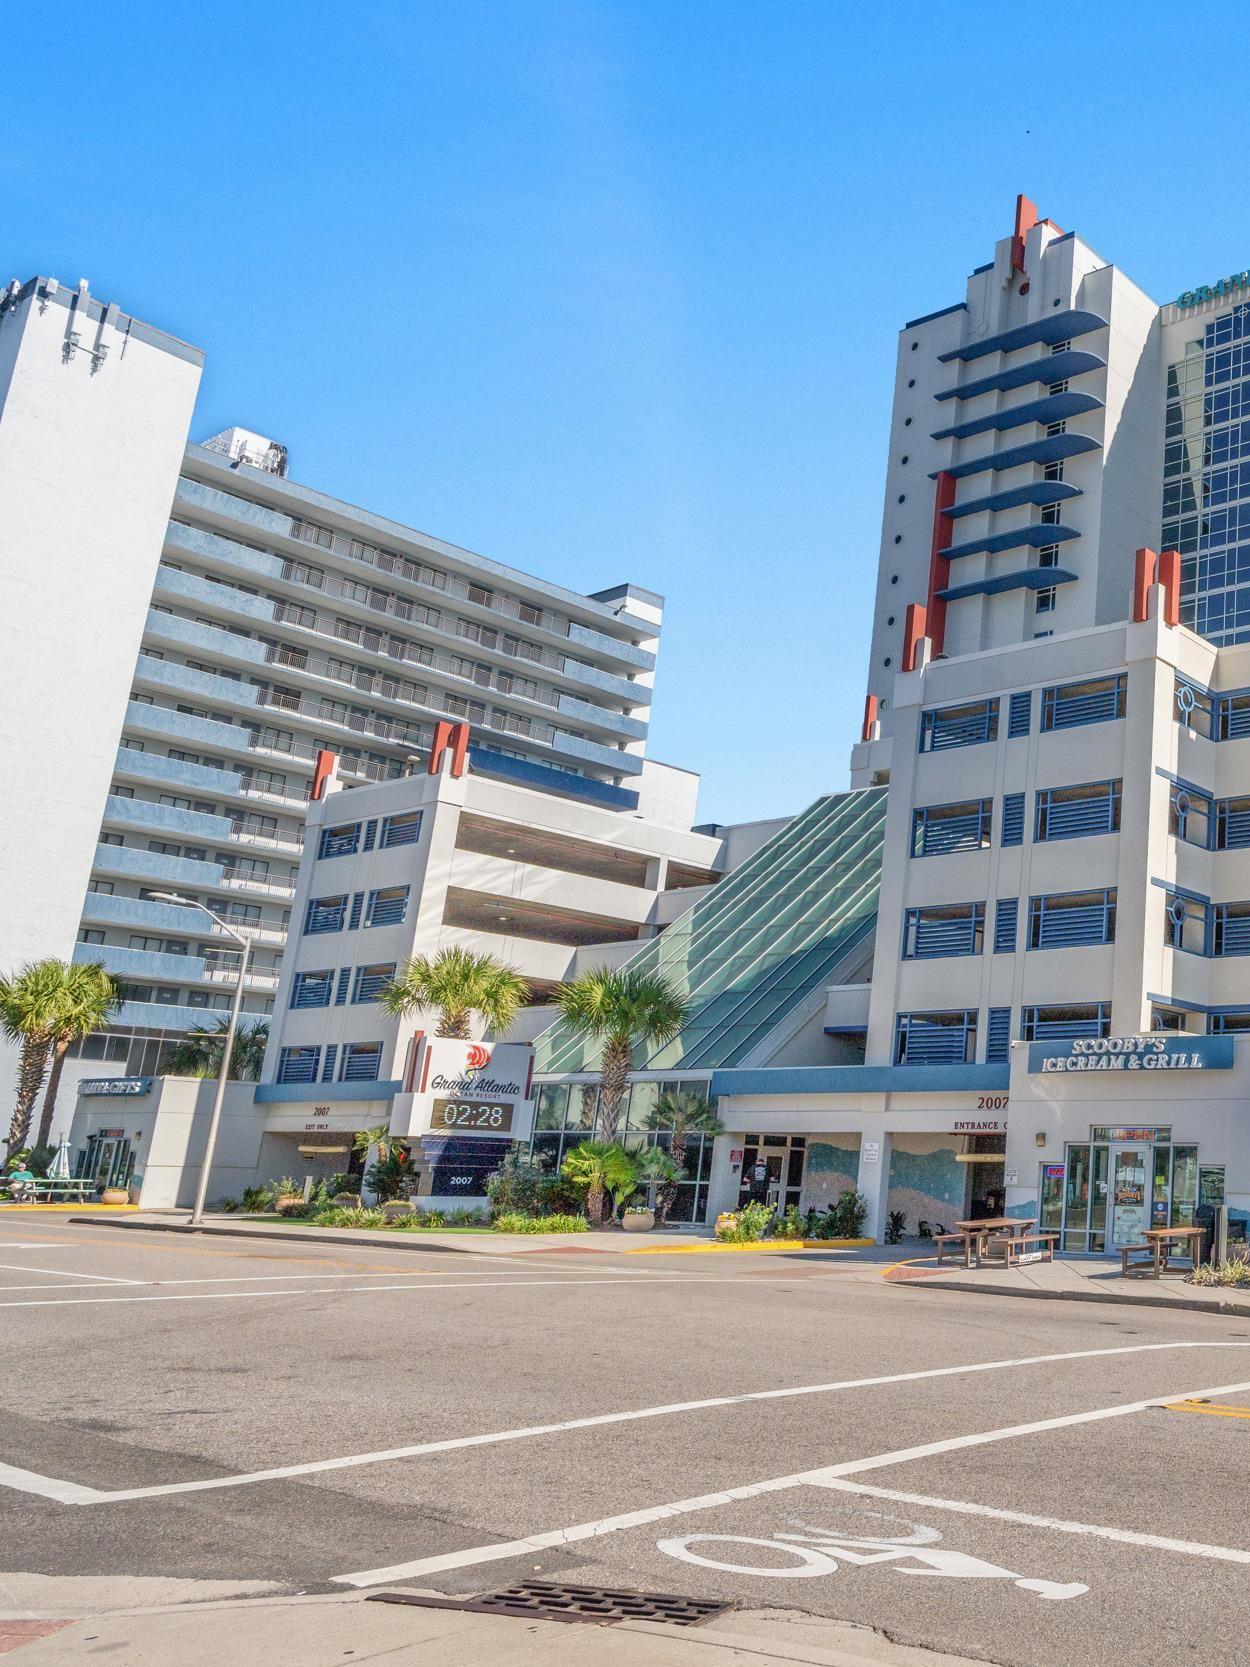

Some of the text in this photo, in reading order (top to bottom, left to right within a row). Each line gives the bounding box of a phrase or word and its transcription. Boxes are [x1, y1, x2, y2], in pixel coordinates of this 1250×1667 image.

[1072, 1038, 1167, 1054] SCOOBY'S
[1128, 1054, 1141, 1069] &
[1142, 1053, 1202, 1069] GRILL
[431, 1075, 520, 1095] Grand Atlantic
[977, 1096, 1009, 1109] 2007
[313, 1106, 330, 1116] 2007
[444, 1104, 503, 1126] 02:28
[954, 1122, 999, 1130] ENTRANCE
[450, 1177, 473, 1185] 2007
